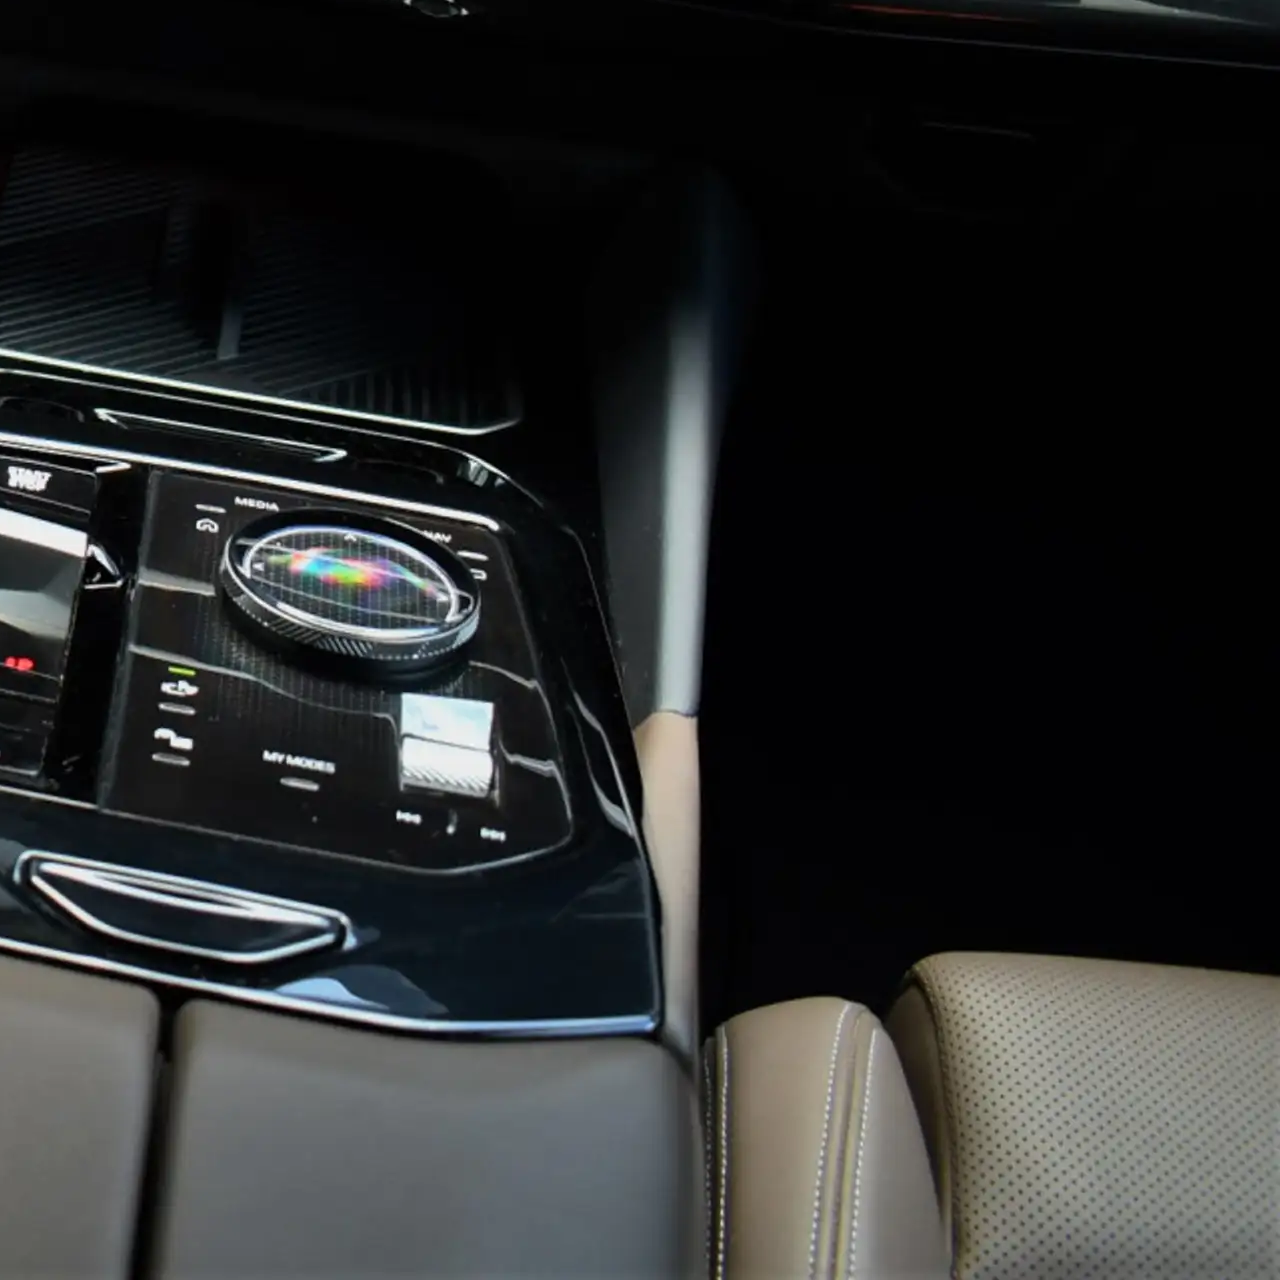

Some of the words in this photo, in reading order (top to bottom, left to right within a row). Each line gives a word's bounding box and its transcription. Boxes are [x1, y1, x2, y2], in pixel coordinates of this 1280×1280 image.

[234, 496, 281, 512] MEDIA
[422, 529, 452, 544] NAV
[262, 749, 285, 765] MY
[285, 753, 336, 775] MODES
